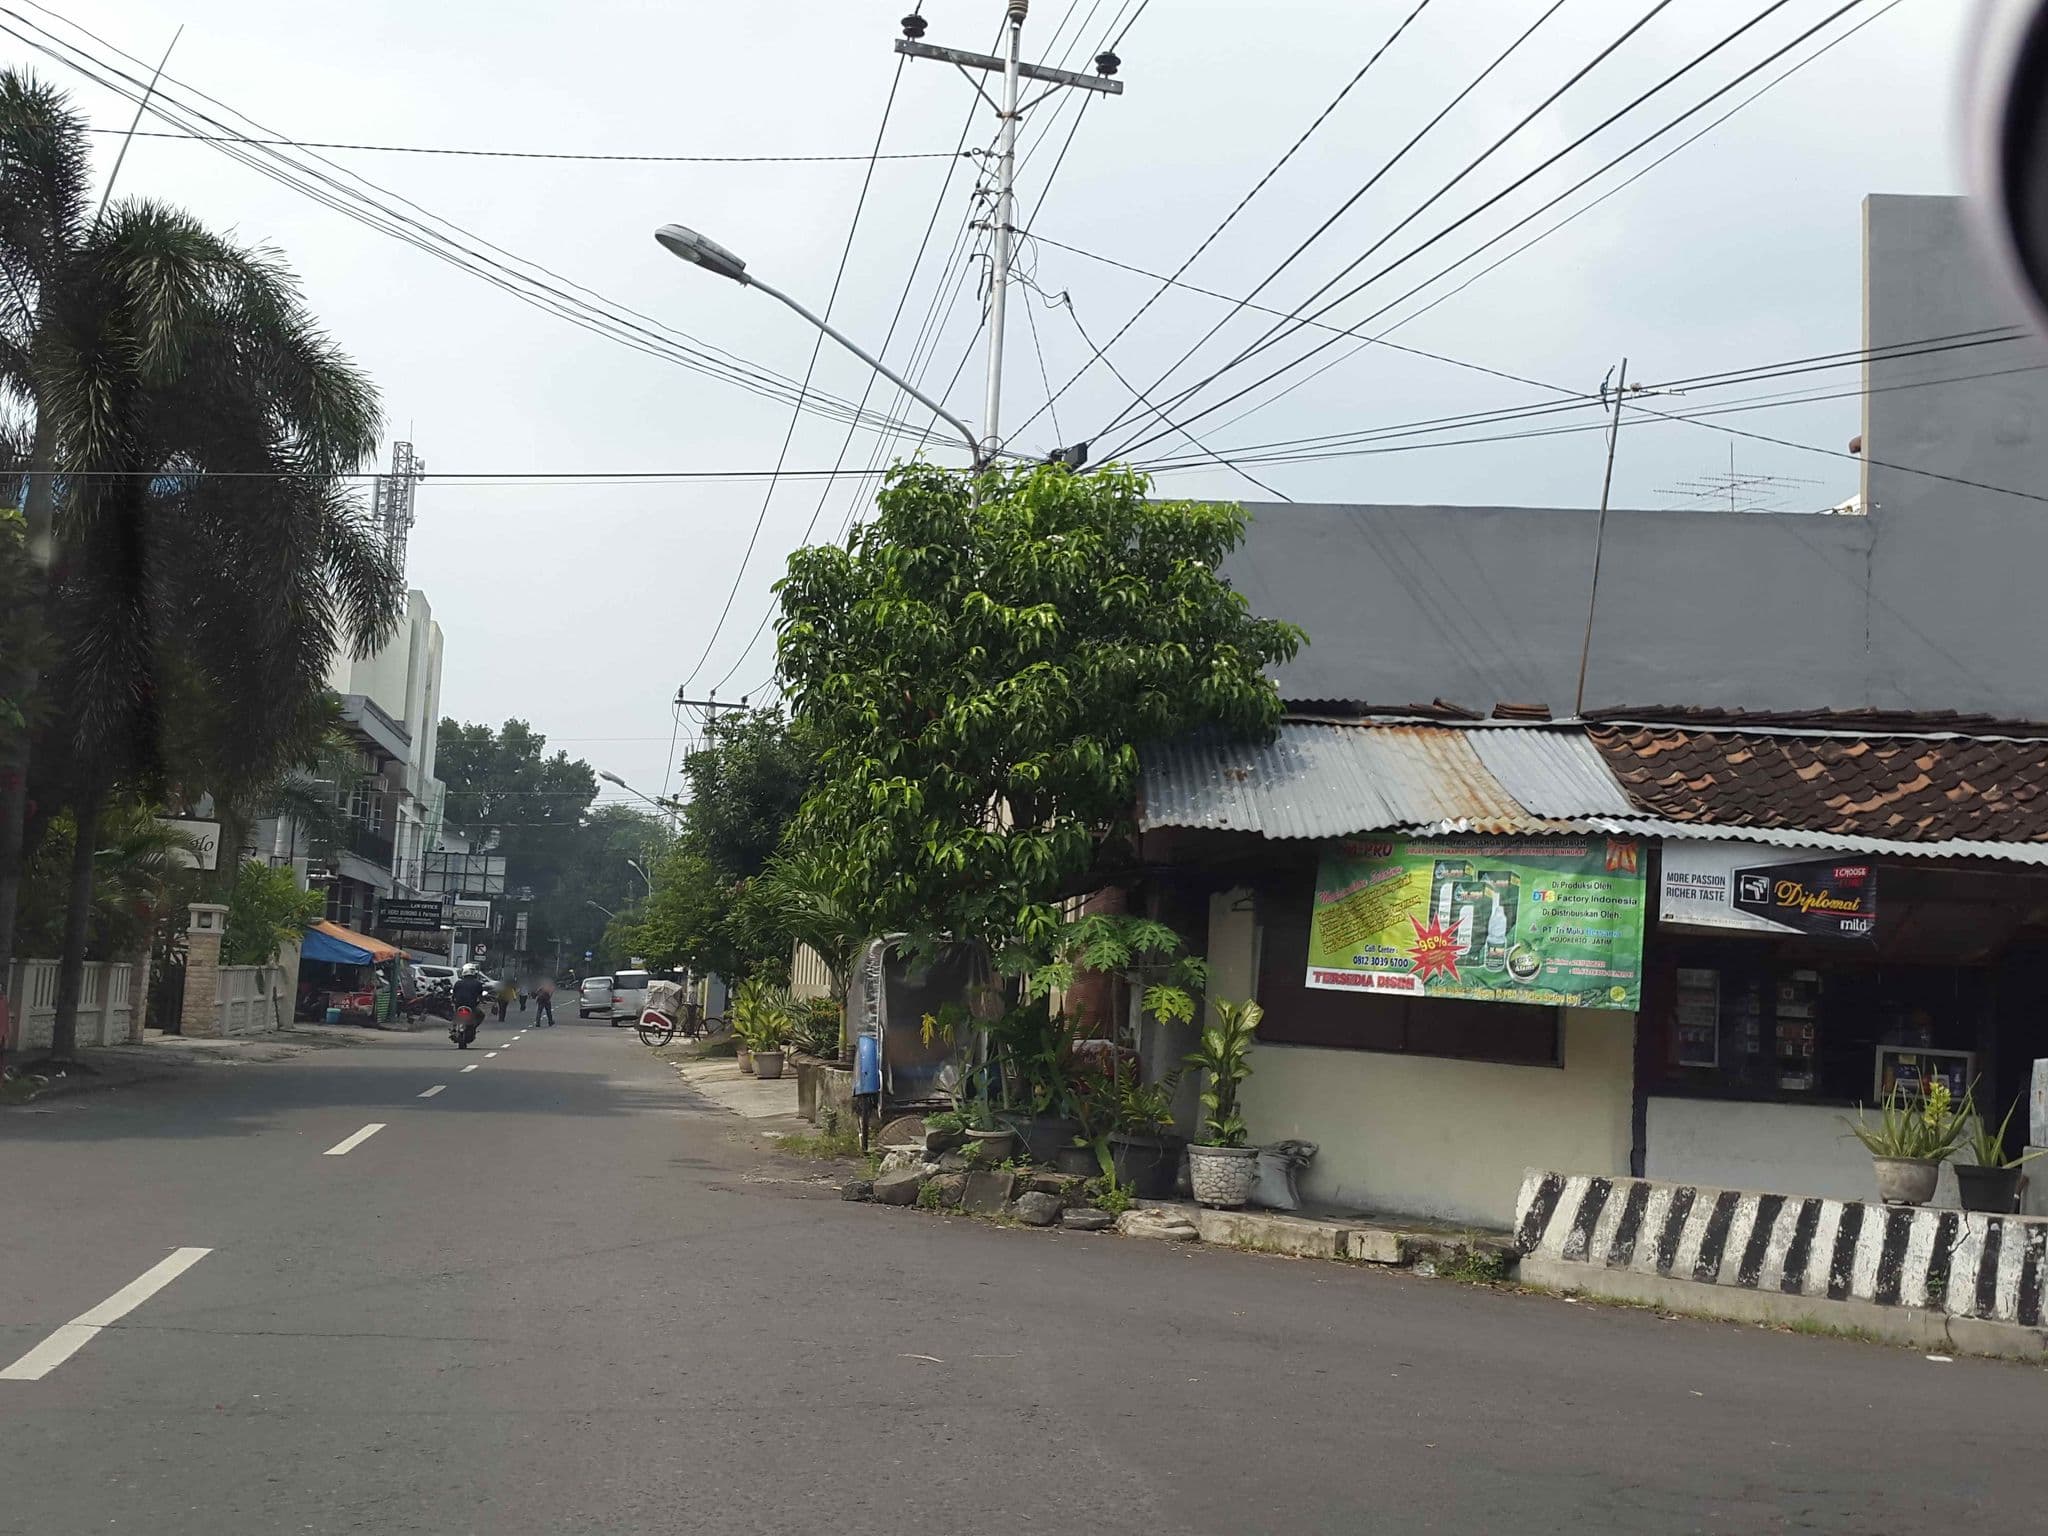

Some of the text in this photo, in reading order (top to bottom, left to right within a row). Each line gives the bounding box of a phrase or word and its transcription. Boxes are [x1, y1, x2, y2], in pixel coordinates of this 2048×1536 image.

[1561, 881, 1592, 889] Produksi
[1594, 882, 1612, 890] Oleh
[1666, 872, 1726, 886] MORE PASSION
[1557, 894, 1590, 904] Factory
[1591, 895, 1638, 905] Indonesia
[1666, 887, 1725, 901] RICHER TASTE
[1774, 880, 1862, 913] Diplomat
[1552, 909, 1598, 918] Distribusikan
[1840, 918, 1868, 931] mild
[1419, 935, 1447, 951] 96%
[1353, 955, 1409, 968] 0812 3039 6700
[1313, 971, 1416, 990] TERSEDIA DISINI
